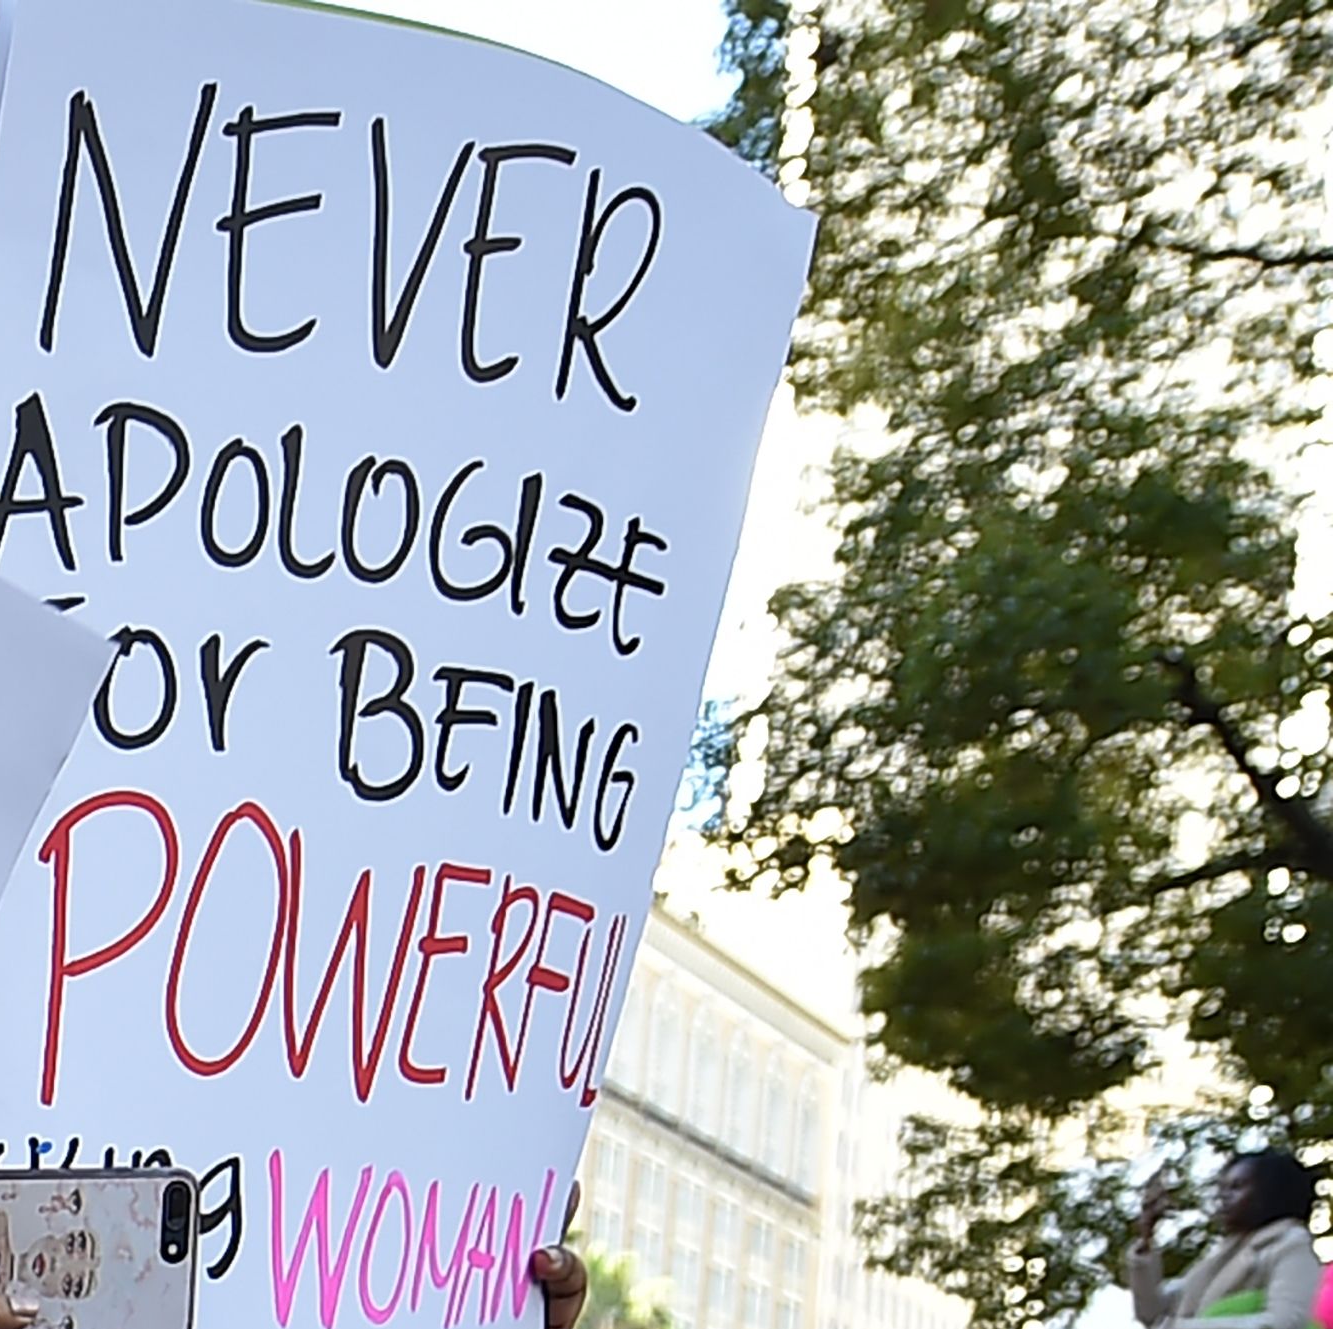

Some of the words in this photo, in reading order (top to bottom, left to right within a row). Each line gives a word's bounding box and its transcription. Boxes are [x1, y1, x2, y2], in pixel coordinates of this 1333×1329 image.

[39, 82, 662, 412] NEVER
[331, 629, 640, 852] BEING
[41, 789, 627, 1108] POWERFUL
